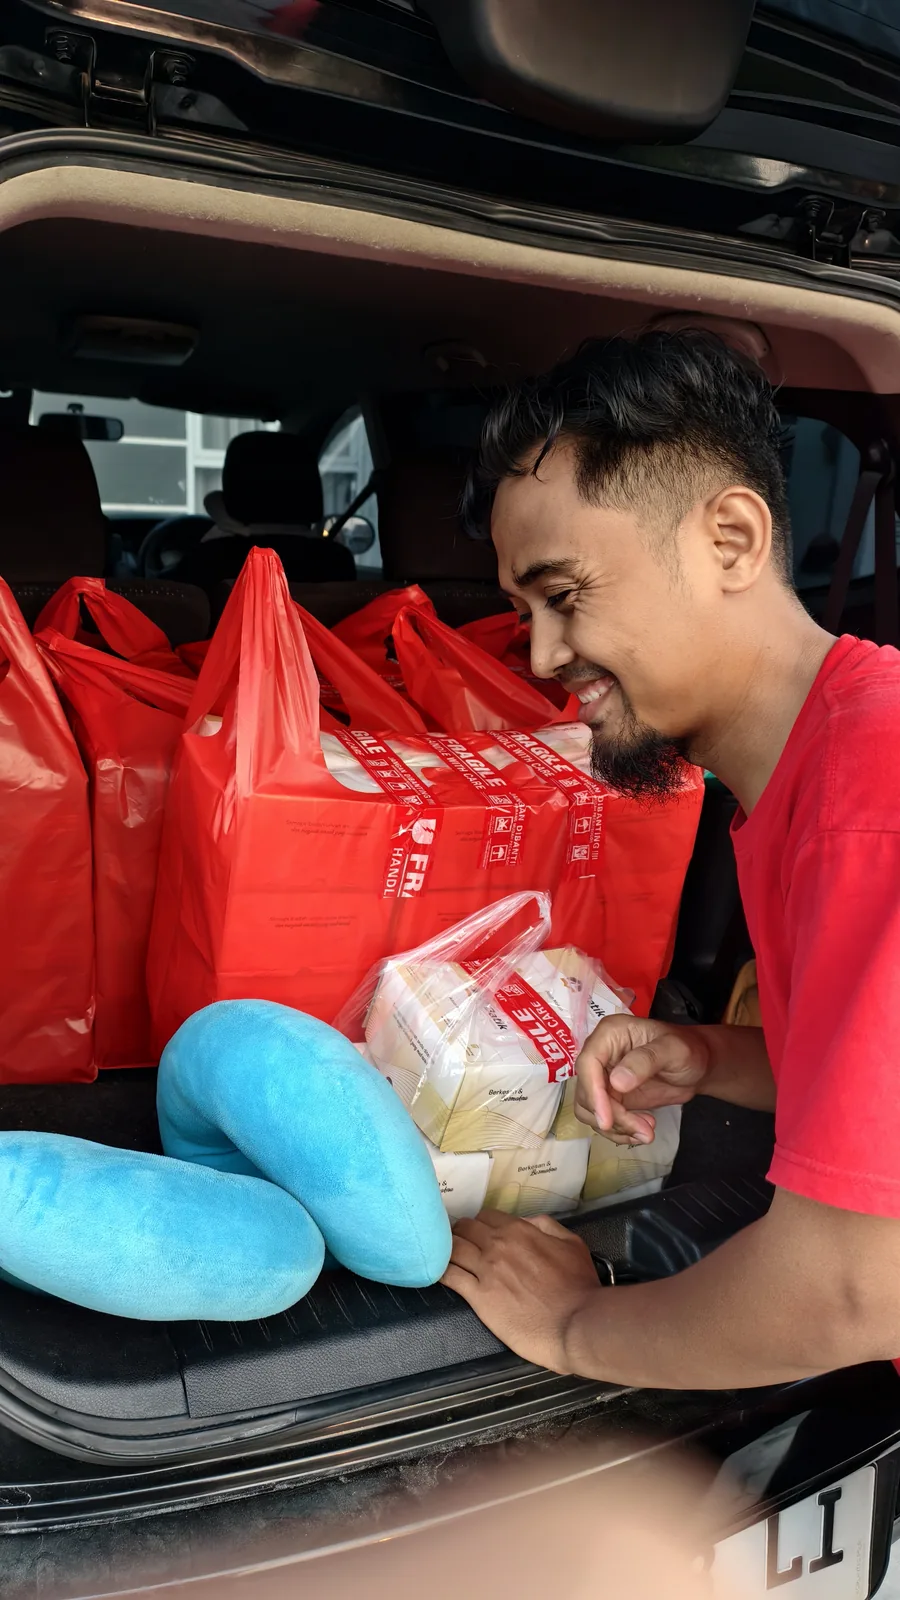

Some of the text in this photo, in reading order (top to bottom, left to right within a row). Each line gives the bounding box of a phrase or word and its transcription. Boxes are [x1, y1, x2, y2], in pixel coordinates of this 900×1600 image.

[442, 738, 507, 787] FRAGILE
[504, 730, 573, 773] FRAGILE
[513, 748, 532, 764] WITH
[531, 762, 555, 778] CARE
[446, 756, 466, 773] WITH
[463, 772, 487, 790] CARE
[593, 796, 604, 849] DIBANTING
[383, 847, 404, 899] HANDL
[530, 1000, 559, 1028] CARE
[517, 1163, 546, 1173] Berkesan
